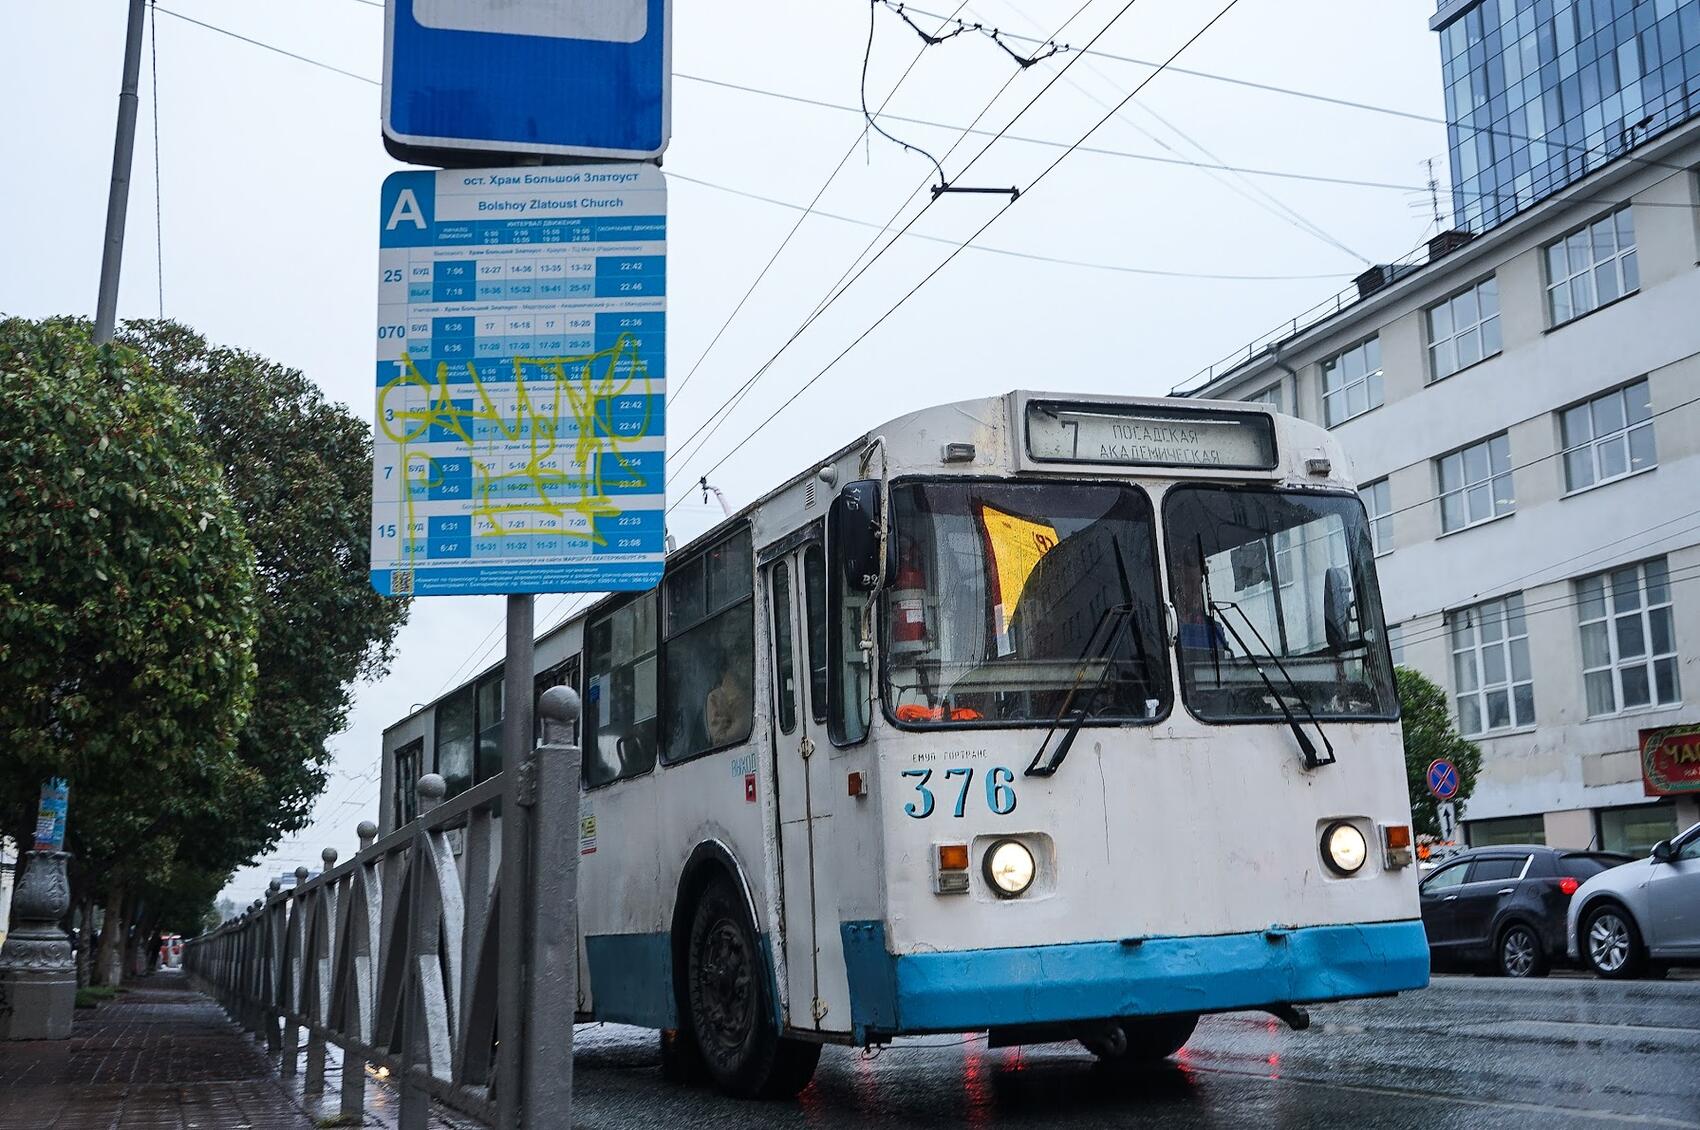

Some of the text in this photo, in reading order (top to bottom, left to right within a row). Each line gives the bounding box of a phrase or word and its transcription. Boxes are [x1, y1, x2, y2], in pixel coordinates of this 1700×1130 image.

[463, 171, 641, 187] ост. Храм Большой Златоуст
[478, 197, 624, 212] Bolshoy Zlatoust Church
[383, 269, 403, 282] 25
[378, 325, 406, 340] 070
[619, 401, 644, 410] 22:42
[384, 408, 394, 422] 3
[1061, 420, 1078, 459] 7
[1112, 424, 1199, 444] ПОСАДСКАЯ
[1100, 444, 1221, 464] АКАДЕМИЧЕСКАЯ
[384, 466, 394, 480] 7
[378, 524, 397, 539] 15
[944, 749, 988, 761] ГОРТРАНС
[901, 766, 1017, 819] 376
